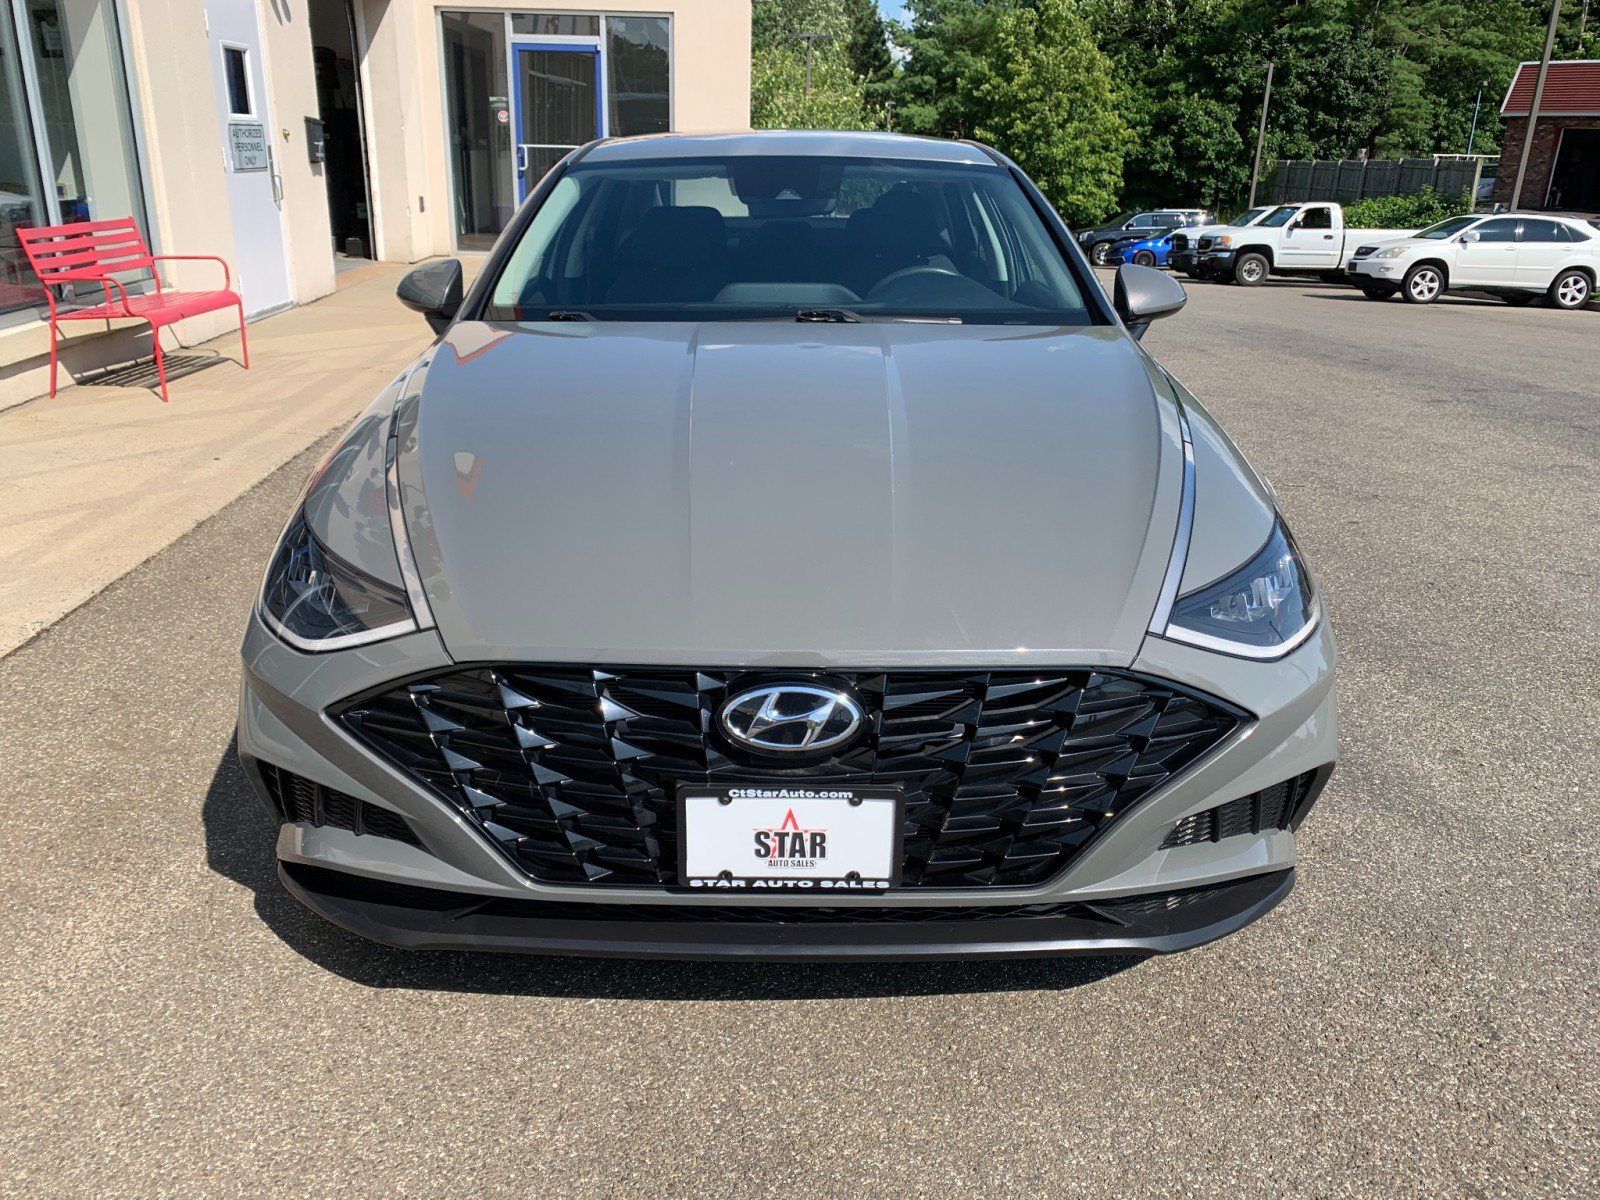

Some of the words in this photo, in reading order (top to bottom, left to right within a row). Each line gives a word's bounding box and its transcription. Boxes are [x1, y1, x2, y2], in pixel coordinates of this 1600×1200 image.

[232, 128, 262, 139] AUTHORIZED
[234, 142, 264, 152] PERSONNEL
[244, 156, 257, 166] ONLY
[728, 789, 854, 799] CtStarAuto.com
[754, 831, 827, 859] STAR
[767, 859, 788, 868] AUTO
[791, 859, 816, 868] SALES
[689, 879, 746, 888] STAR
[752, 880, 814, 888] AUTO
[819, 880, 890, 889] SALES
